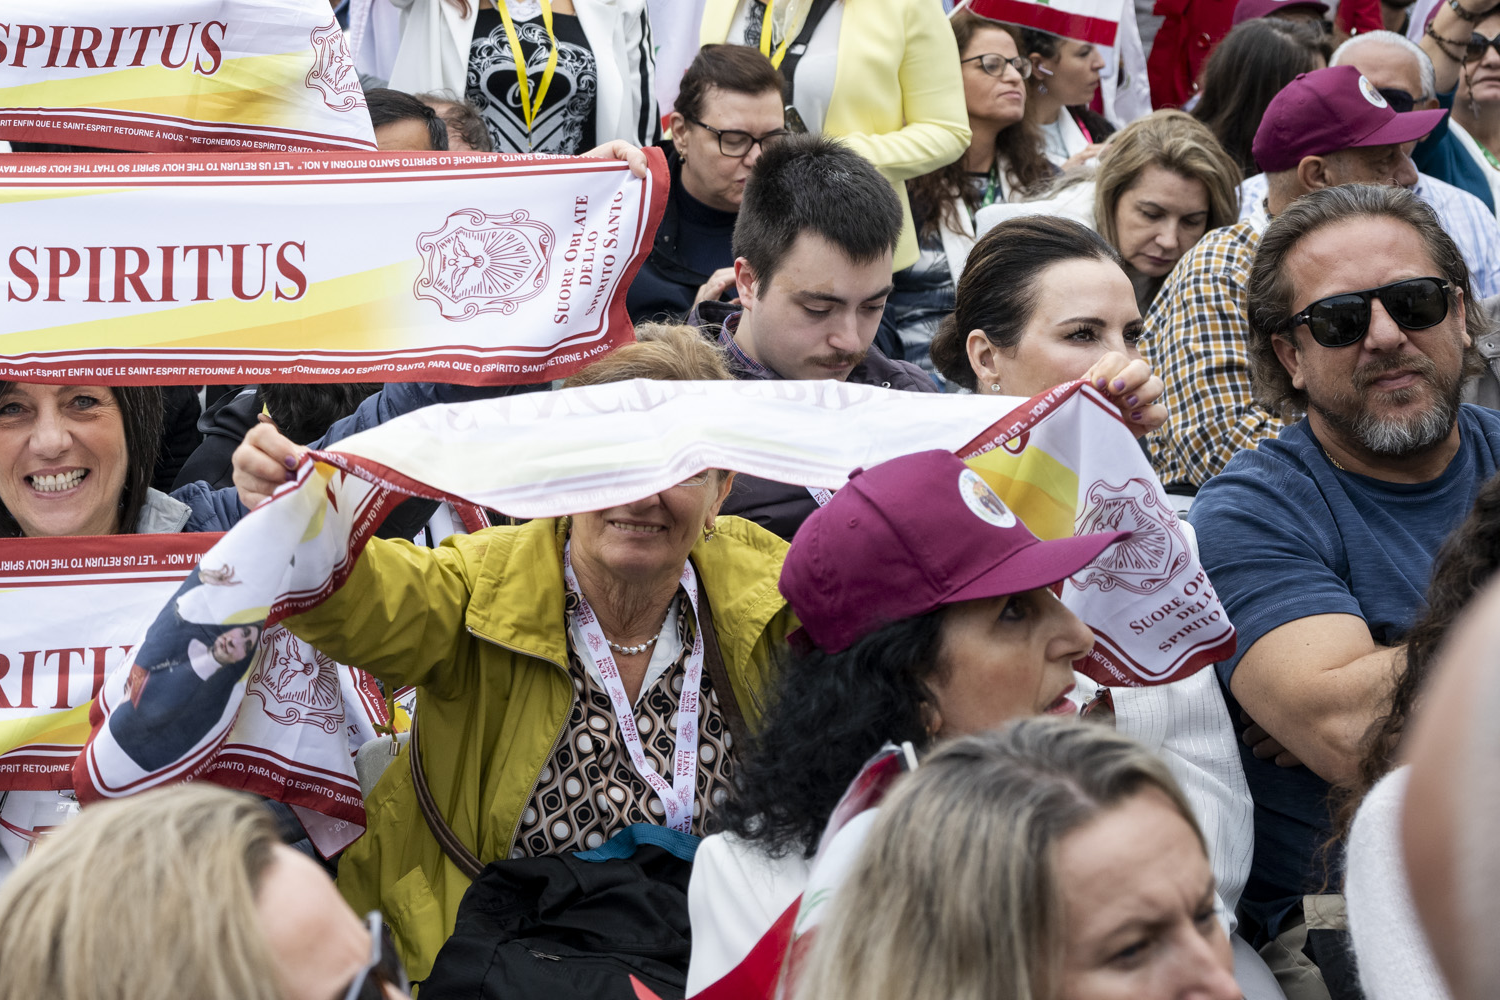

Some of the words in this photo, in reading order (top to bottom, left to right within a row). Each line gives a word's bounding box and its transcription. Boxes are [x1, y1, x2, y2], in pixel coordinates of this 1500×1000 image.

[12, 118, 34, 127] ENFIN
[34, 119, 51, 128] QUE
[62, 121, 113, 133] SAINT-ESPRIT
[113, 125, 154, 137] RETOURNE
[252, 140, 287, 152] ESPÍRITO
[330, 159, 367, 169] RITORNI
[368, 157, 400, 168] SANTO
[401, 156, 437, 167] SPIRITO
[452, 154, 498, 166] AFFINCHÉ
[17, 164, 47, 173] SPIRIT
[47, 164, 72, 173] HOLY
[72, 164, 91, 173] THE
[91, 164, 115, 173] THAT
[130, 163, 160, 172] SPIRIT
[160, 162, 185, 172] HOLY
[186, 162, 204, 171] THE
[219, 161, 257, 171] RETURN
[564, 195, 588, 262] OBLATE
[579, 230, 598, 286] DELLO
[585, 254, 616, 316] SPIRITO
[603, 191, 623, 248] SANTO
[7, 240, 307, 303] SPIRITUS
[554, 267, 575, 324] SUORE
[7, 367, 66, 377] SAINT-ESPRIT
[67, 367, 94, 376] ENFIN
[94, 366, 113, 376] QUE
[127, 366, 187, 375] SAINT-ESPRIT
[187, 366, 235, 375] RETOURNE
[355, 363, 395, 374] ESPÍRITO
[395, 361, 426, 372] SANTO,
[426, 359, 450, 368] PARA
[451, 360, 472, 371] QUE
[480, 361, 520, 373] ESPÍRITO
[25, 558, 49, 570] HOLY
[50, 558, 69, 569] THE
[84, 556, 121, 567] RETURN
[1129, 596, 1186, 636] SUORE
[1158, 610, 1221, 653] SPIRITO
[595, 659, 608, 680] VENI
[21, 763, 70, 773] RETOURNE
[682, 750, 690, 777] ELENA
[248, 764, 270, 778] PARA
[271, 769, 286, 786] QUE
[295, 779, 334, 798] ESPÍRITO
